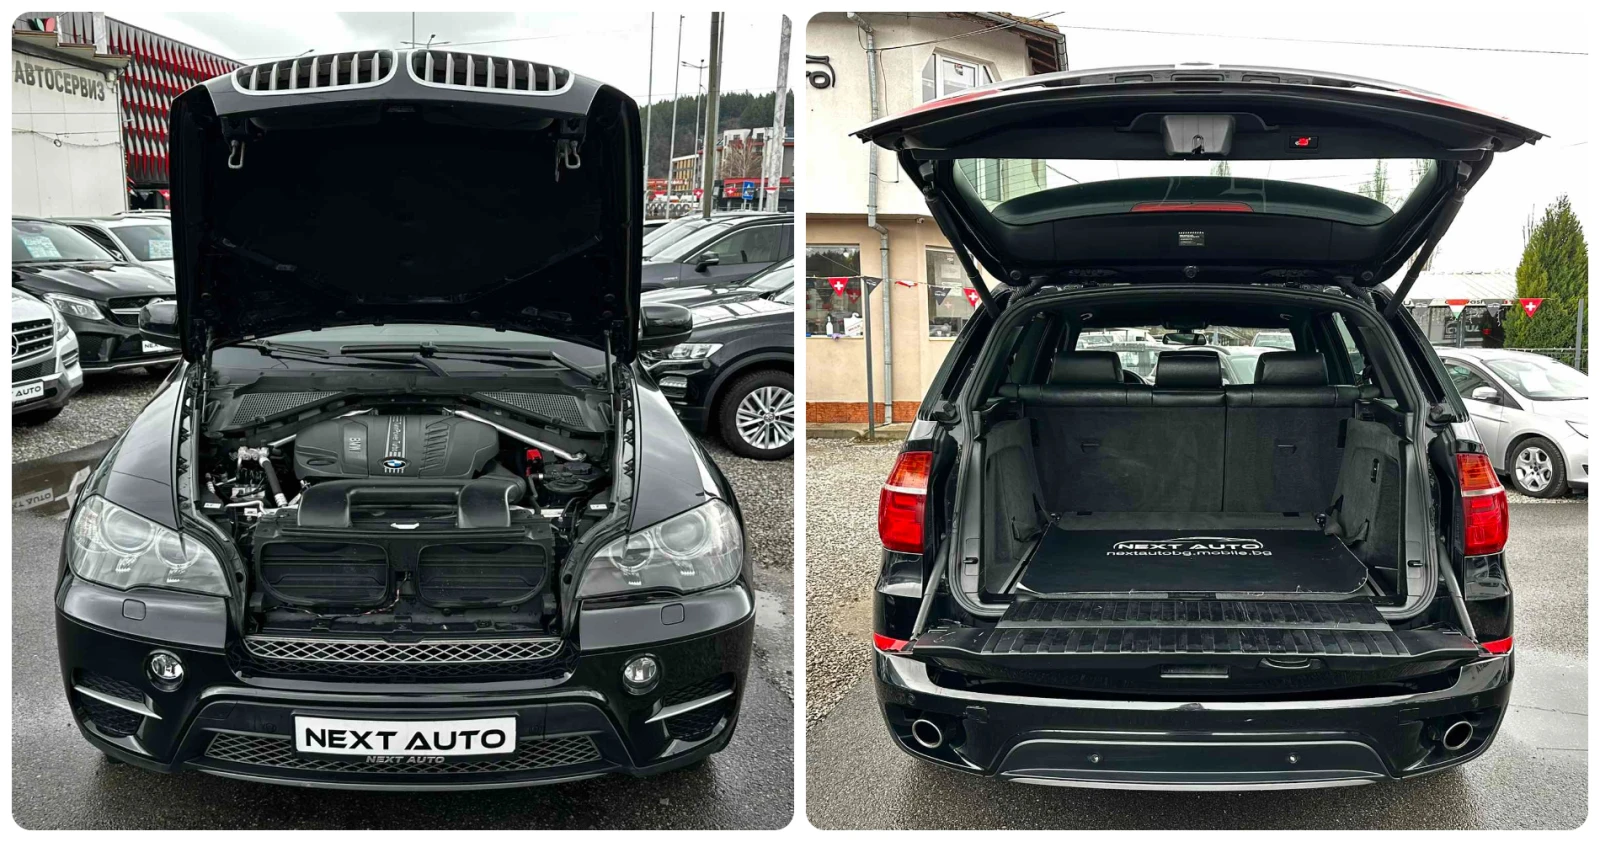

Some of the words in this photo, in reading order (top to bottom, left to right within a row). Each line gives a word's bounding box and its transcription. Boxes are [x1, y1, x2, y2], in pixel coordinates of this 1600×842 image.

[14, 60, 105, 101] АВТОСЕРВИЗ
[15, 385, 42, 397] AUTO
[305, 727, 399, 751] NEXT
[404, 728, 506, 751] AUTO
[365, 755, 404, 764] NEXT
[406, 755, 445, 764] AUTO
